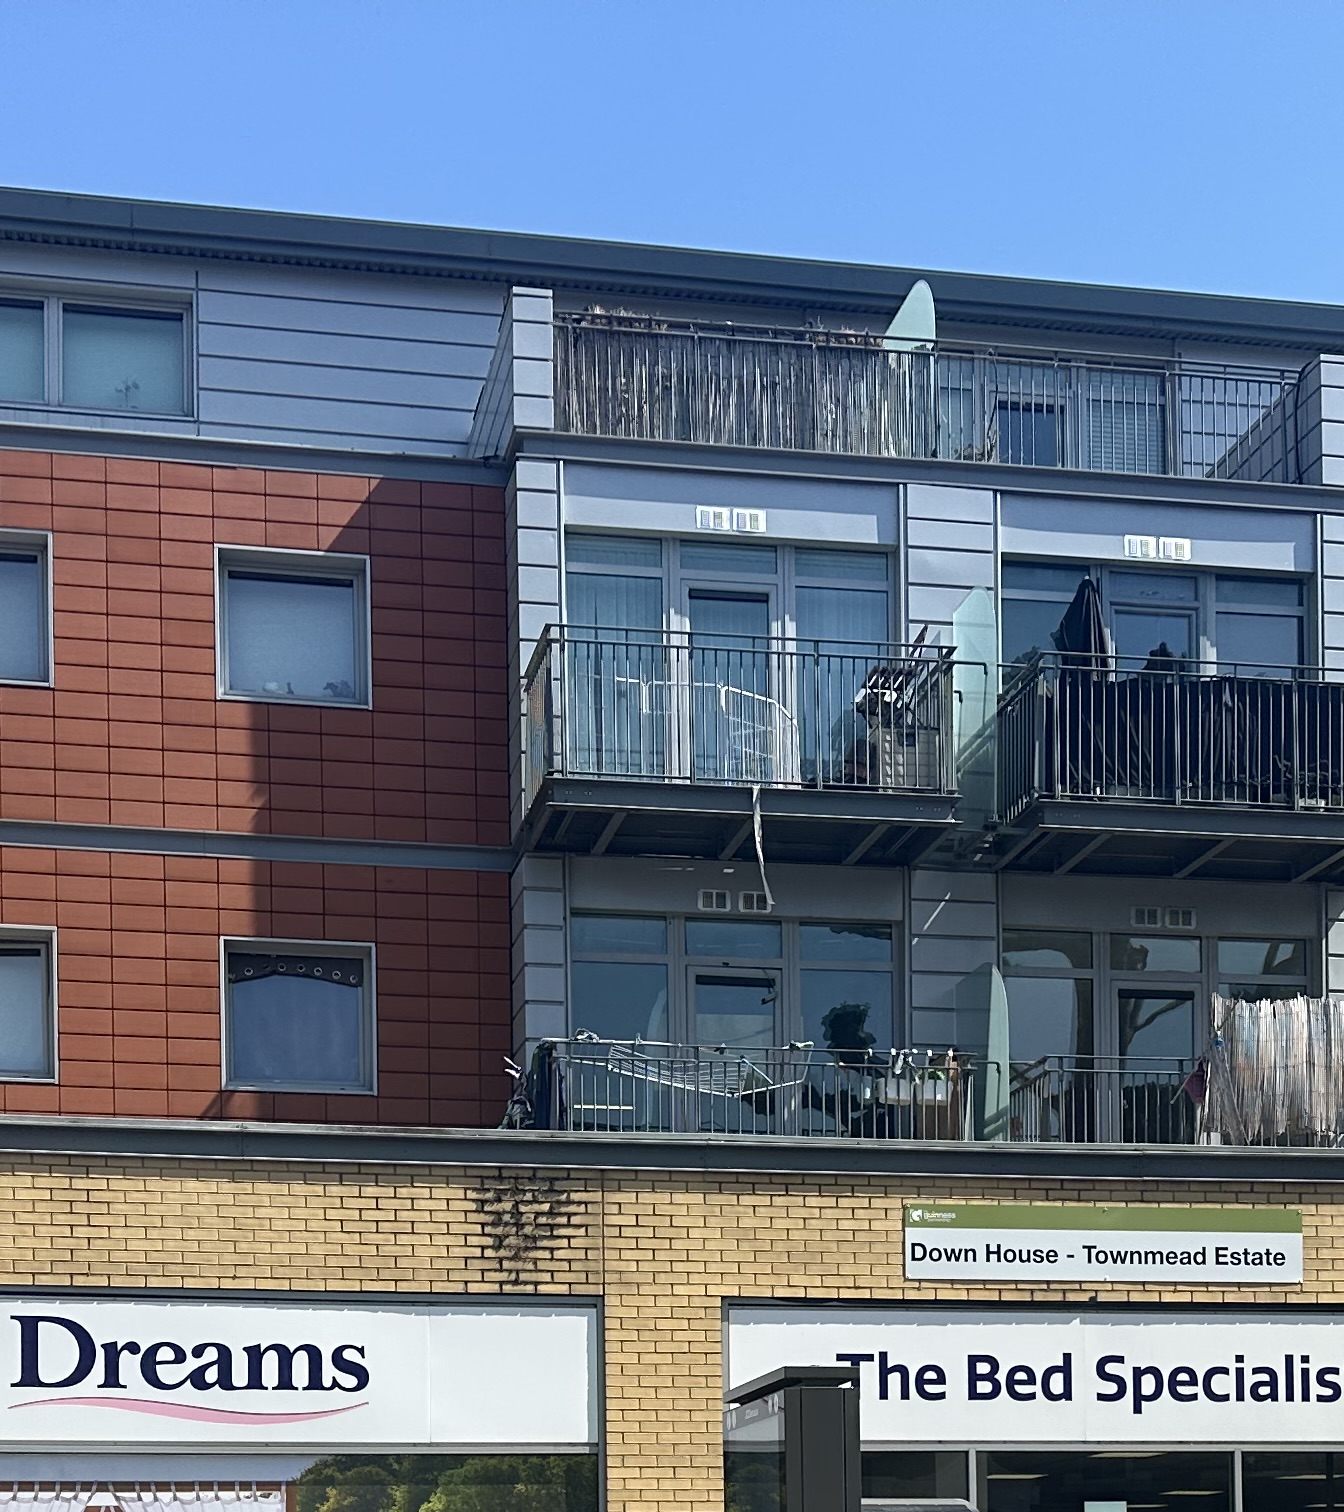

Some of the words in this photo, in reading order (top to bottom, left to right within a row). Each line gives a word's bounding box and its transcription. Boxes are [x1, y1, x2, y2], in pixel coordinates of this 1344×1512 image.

[910, 1242, 977, 1263] Down
[985, 1243, 1059, 1264] House
[1081, 1244, 1207, 1266] Townmead
[1214, 1246, 1287, 1267] Estate
[9, 1315, 370, 1393] Dreams
[967, 1352, 1073, 1402] Bed
